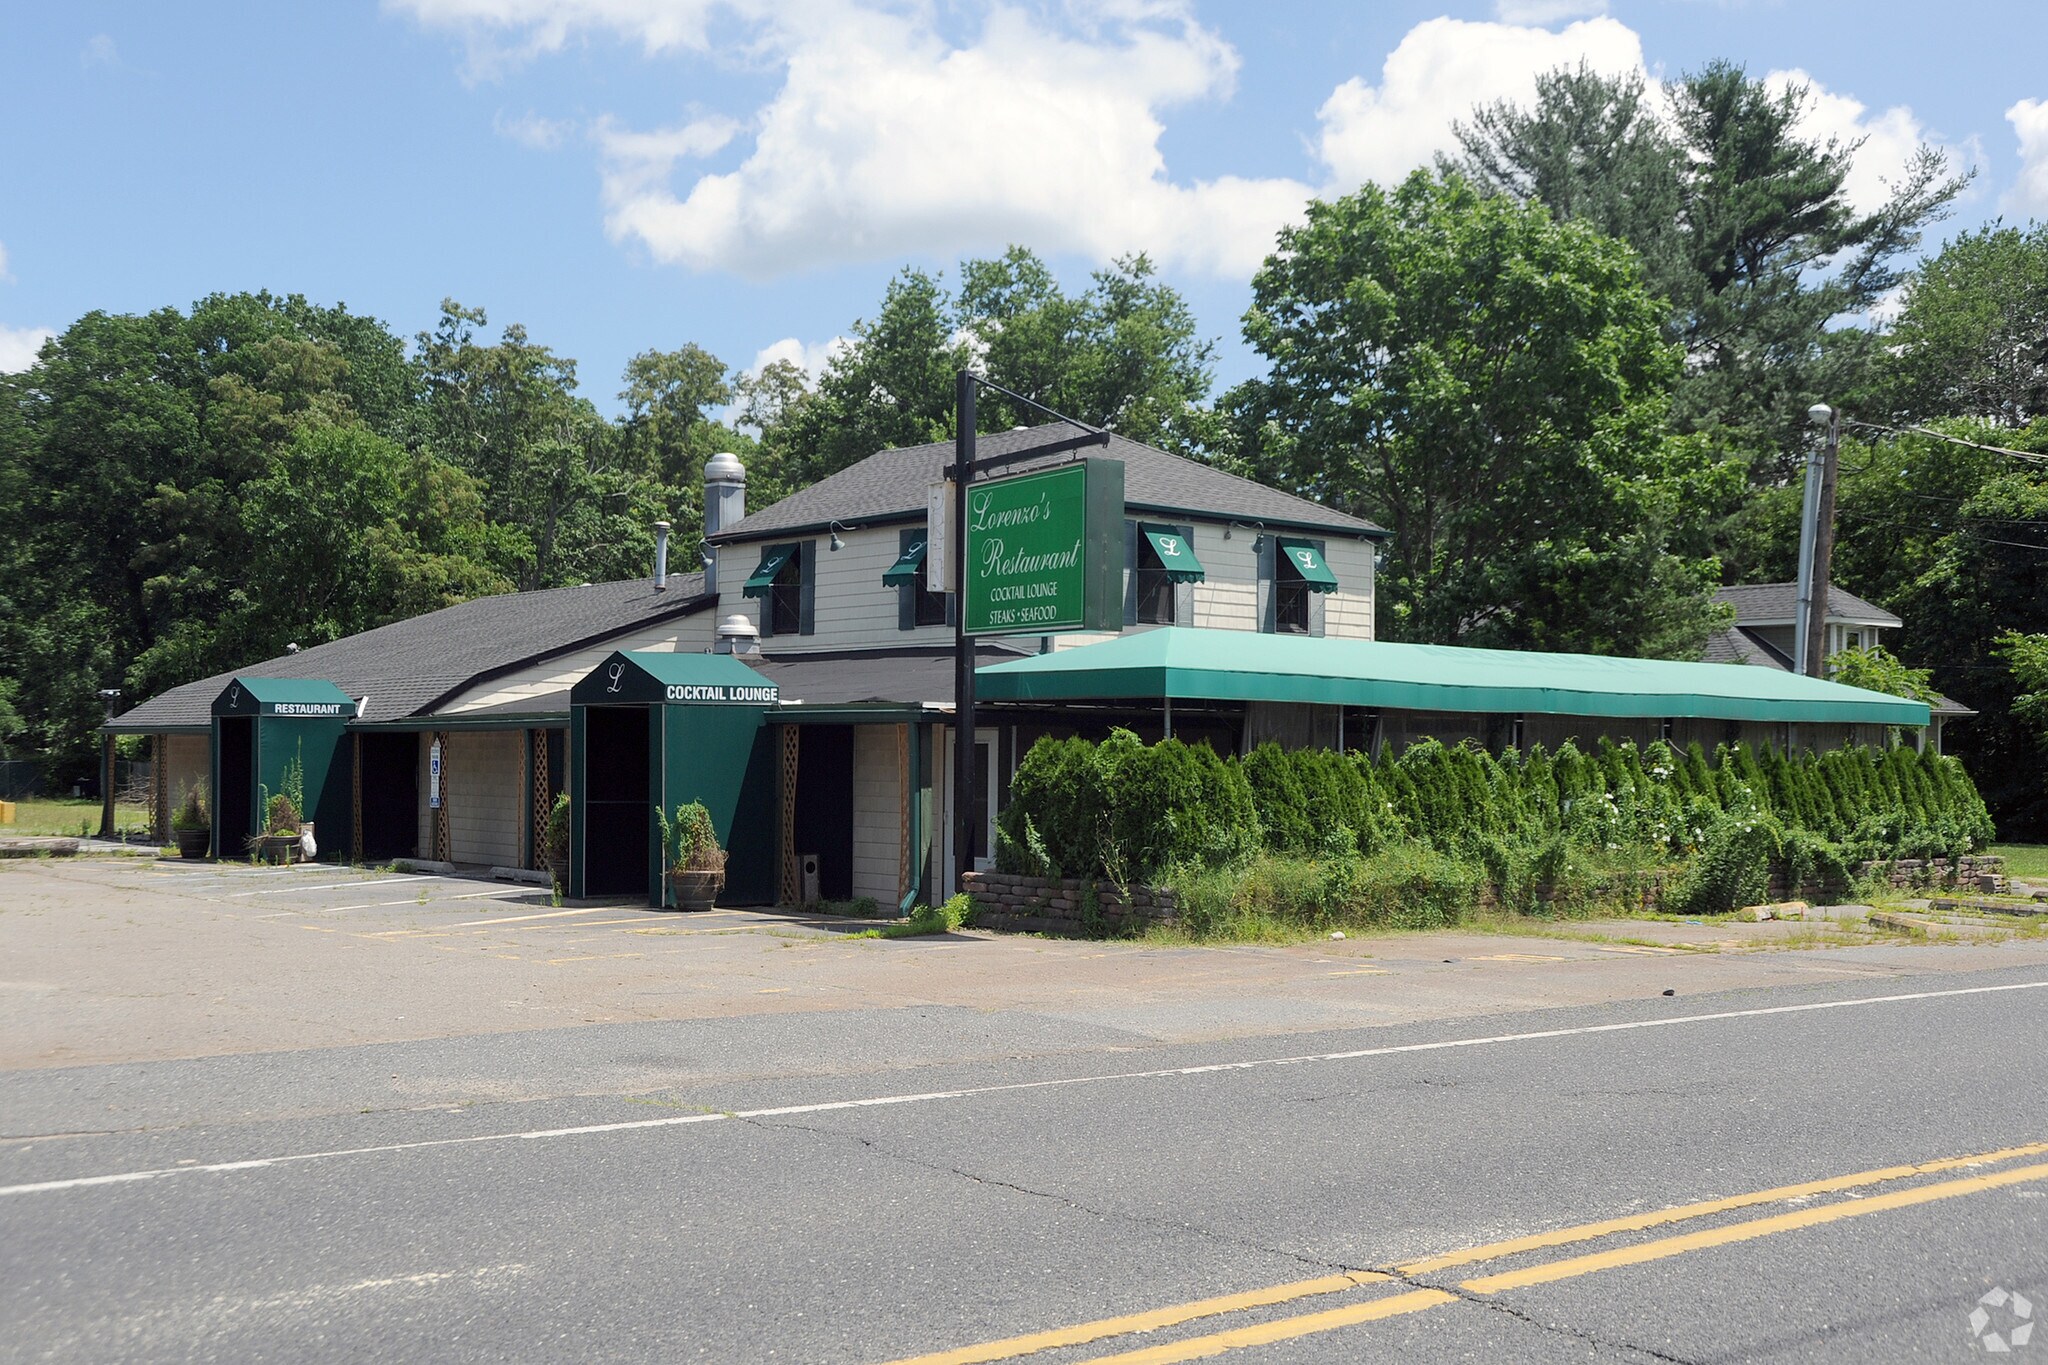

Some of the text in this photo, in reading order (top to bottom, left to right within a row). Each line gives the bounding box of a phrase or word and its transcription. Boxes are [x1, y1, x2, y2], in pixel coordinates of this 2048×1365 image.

[970, 491, 1051, 532] Lorenzo's
[1159, 537, 1181, 556] L
[980, 538, 1081, 578] Restaurant
[1297, 551, 1318, 569] L
[990, 582, 1058, 602] COCKTAIL LOUNGE
[989, 605, 1057, 625] STEAKS SEAFOOD
[607, 662, 625, 693] L
[666, 685, 778, 702] COCKTAIL LOUNGE
[274, 703, 341, 715] RESTAURANT
